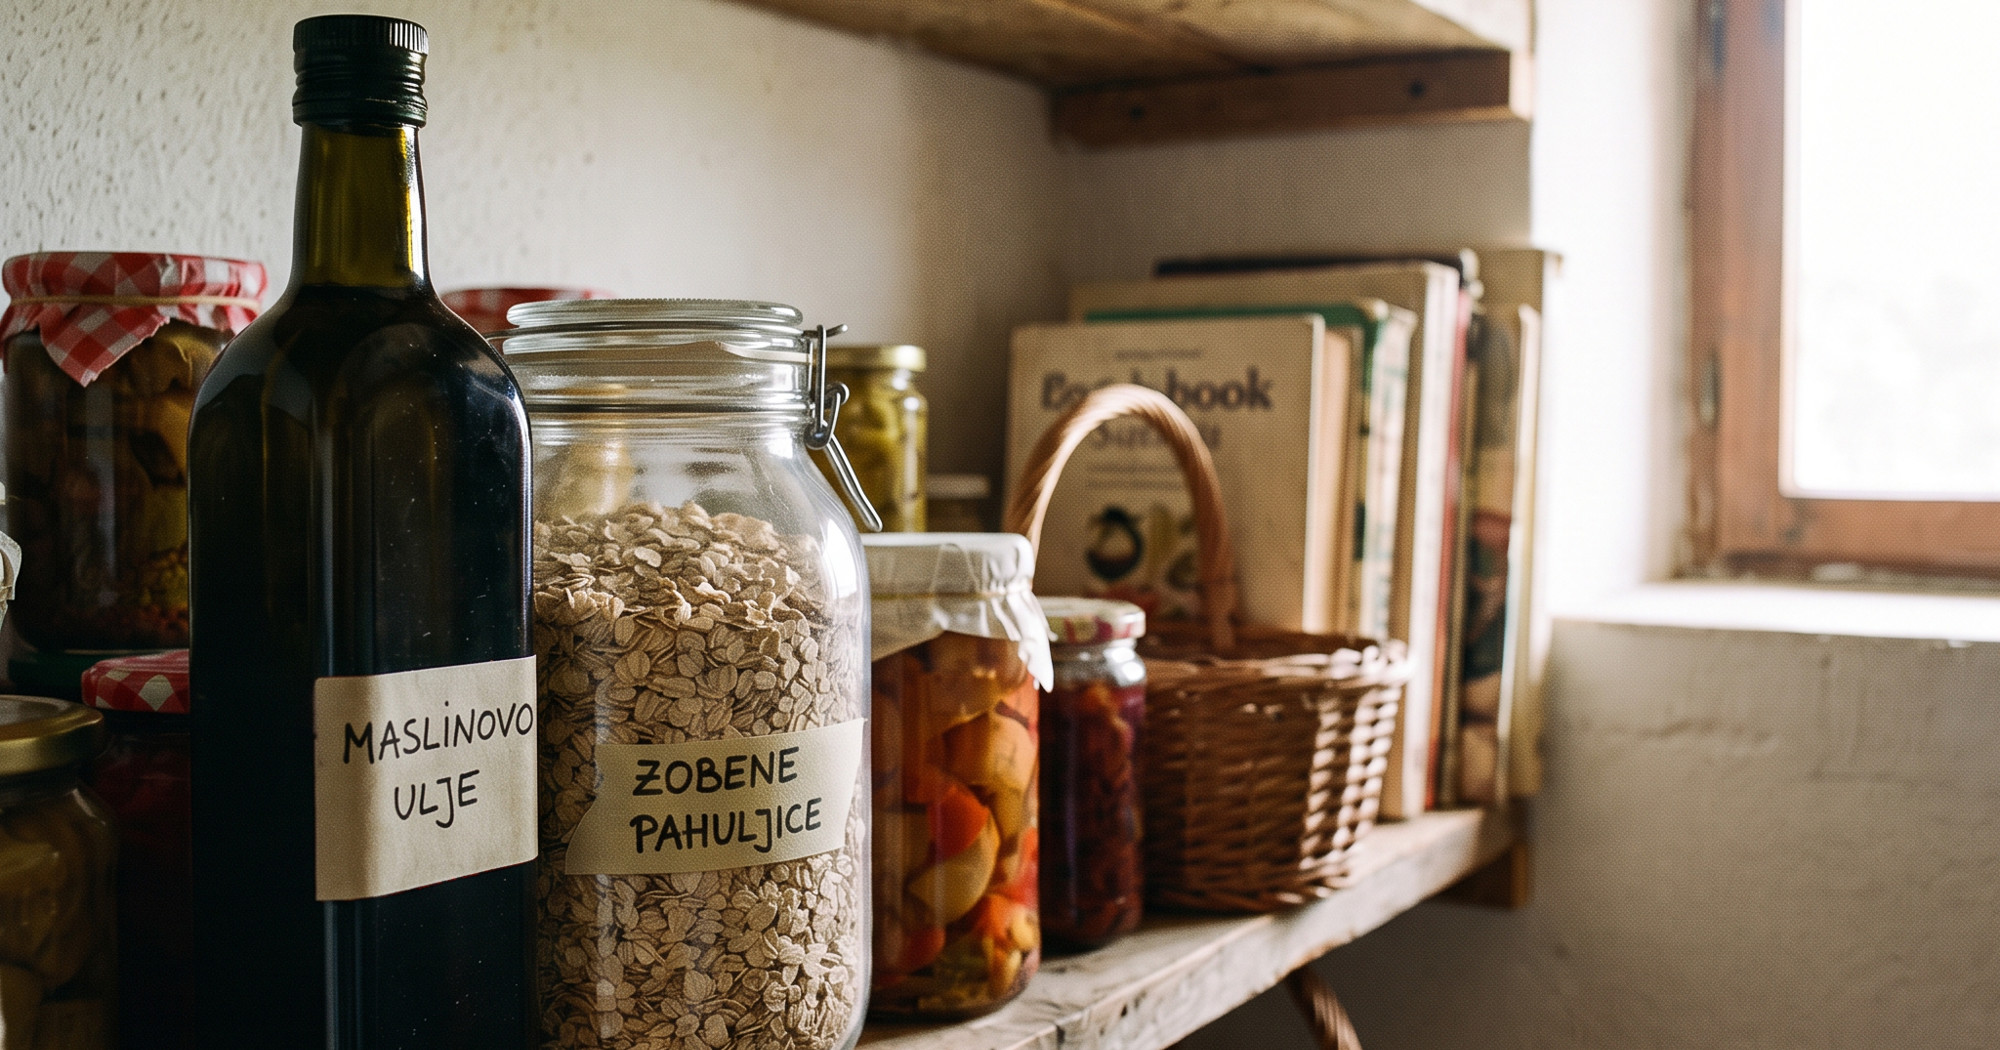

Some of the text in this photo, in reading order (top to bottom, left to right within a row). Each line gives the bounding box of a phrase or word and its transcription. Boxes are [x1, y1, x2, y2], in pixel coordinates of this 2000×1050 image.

[394, 769, 480, 828] ULJE
[632, 746, 800, 796] ZOBENE
[629, 798, 822, 853] PAHULJICE
